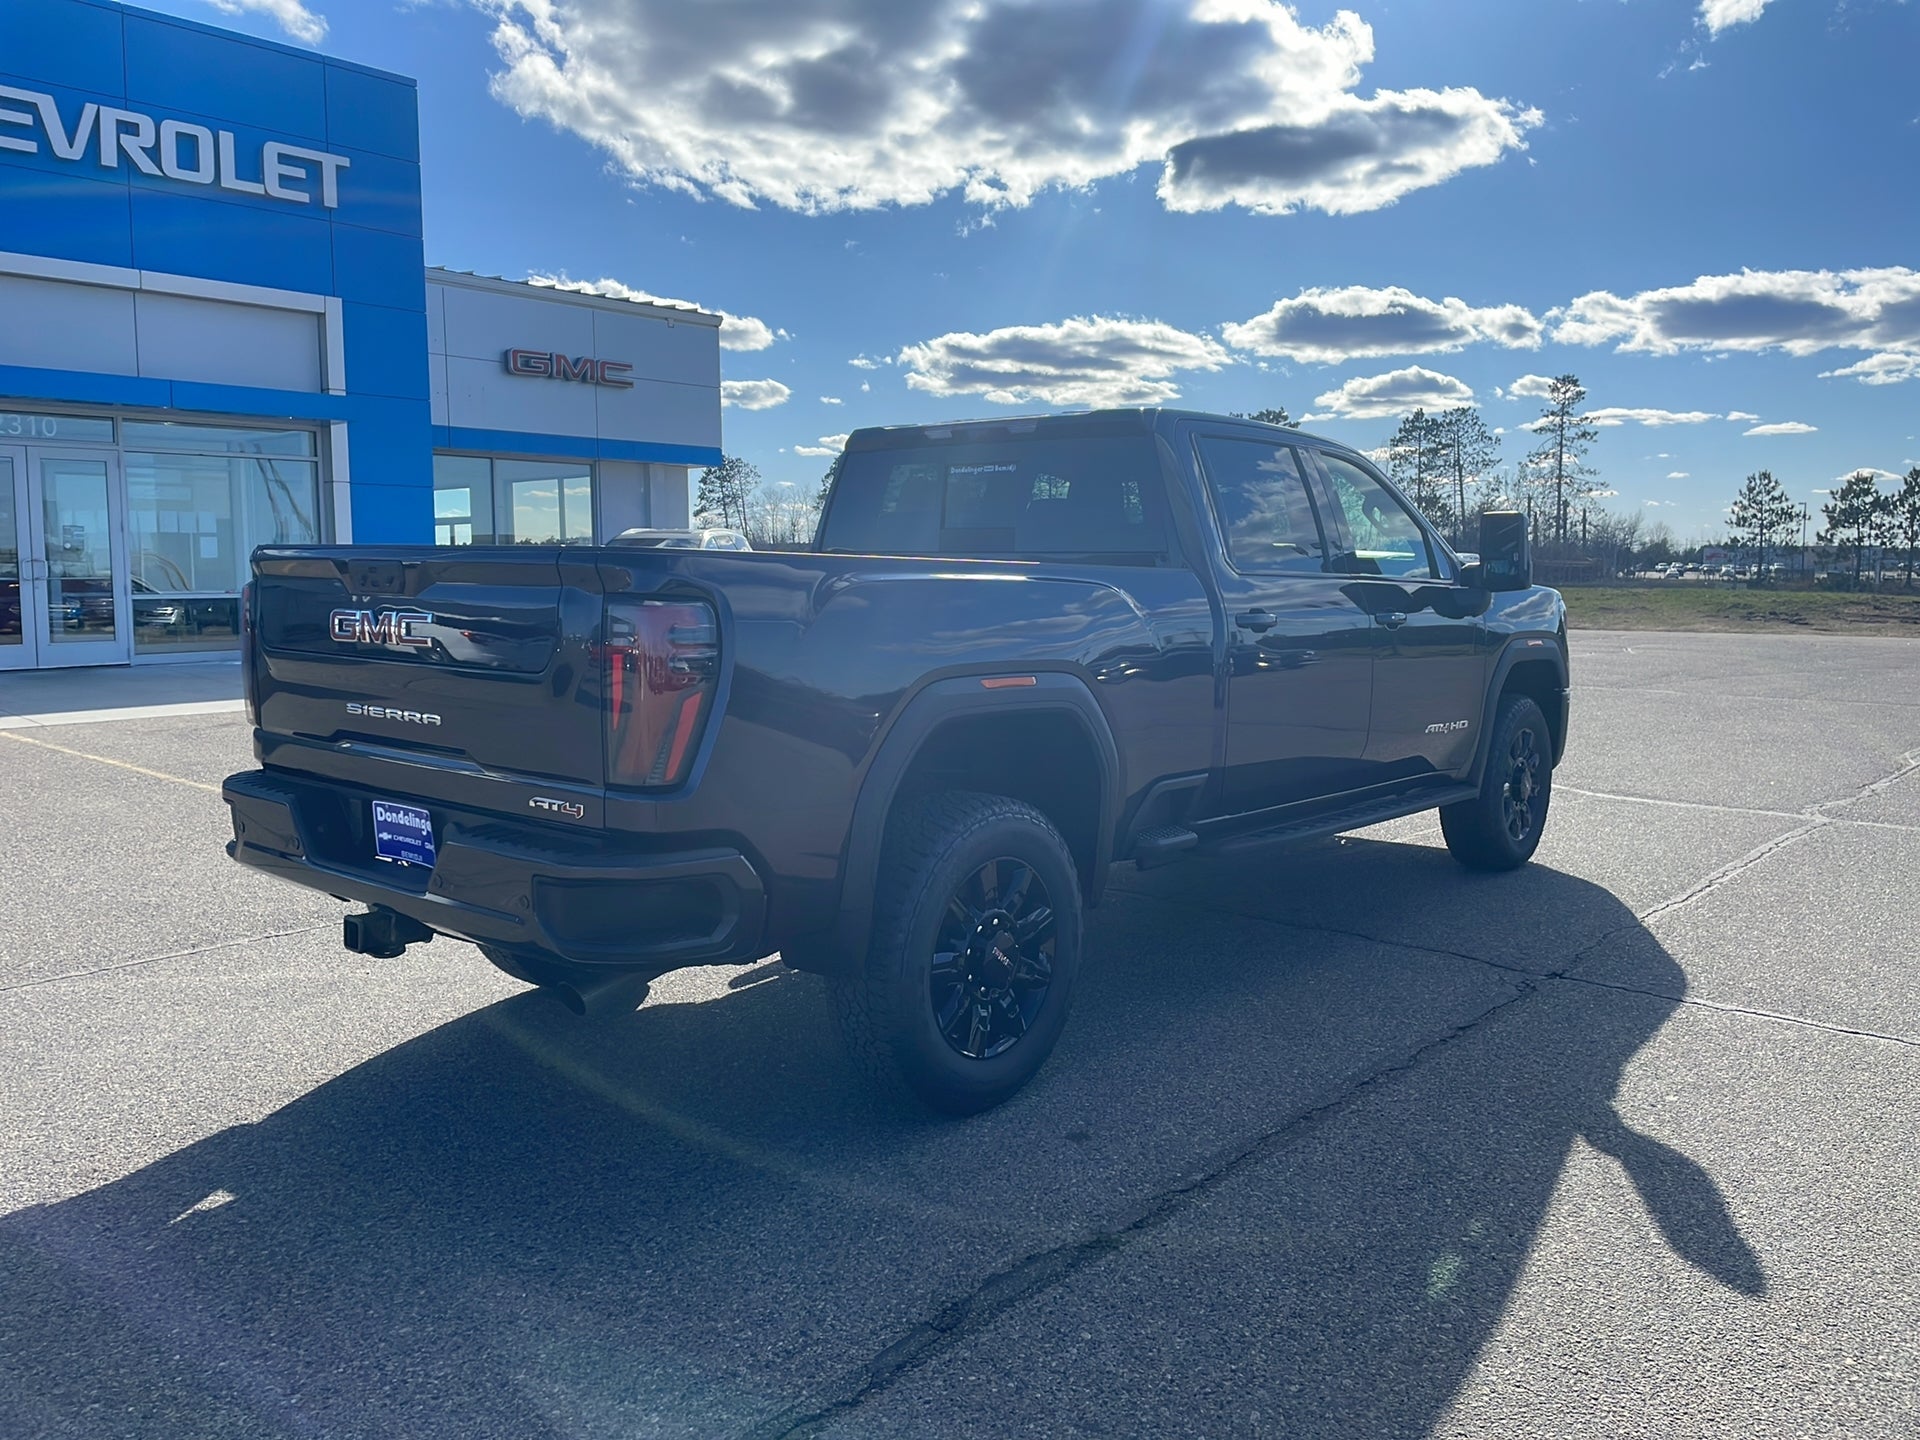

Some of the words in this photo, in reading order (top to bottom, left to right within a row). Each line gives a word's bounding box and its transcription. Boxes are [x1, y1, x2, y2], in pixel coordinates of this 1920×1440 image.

[0, 85, 351, 209] EVROLET
[506, 347, 634, 388] GMC
[330, 608, 433, 647] GMC
[346, 703, 442, 726] SIERRA
[529, 796, 584, 819] AT4
